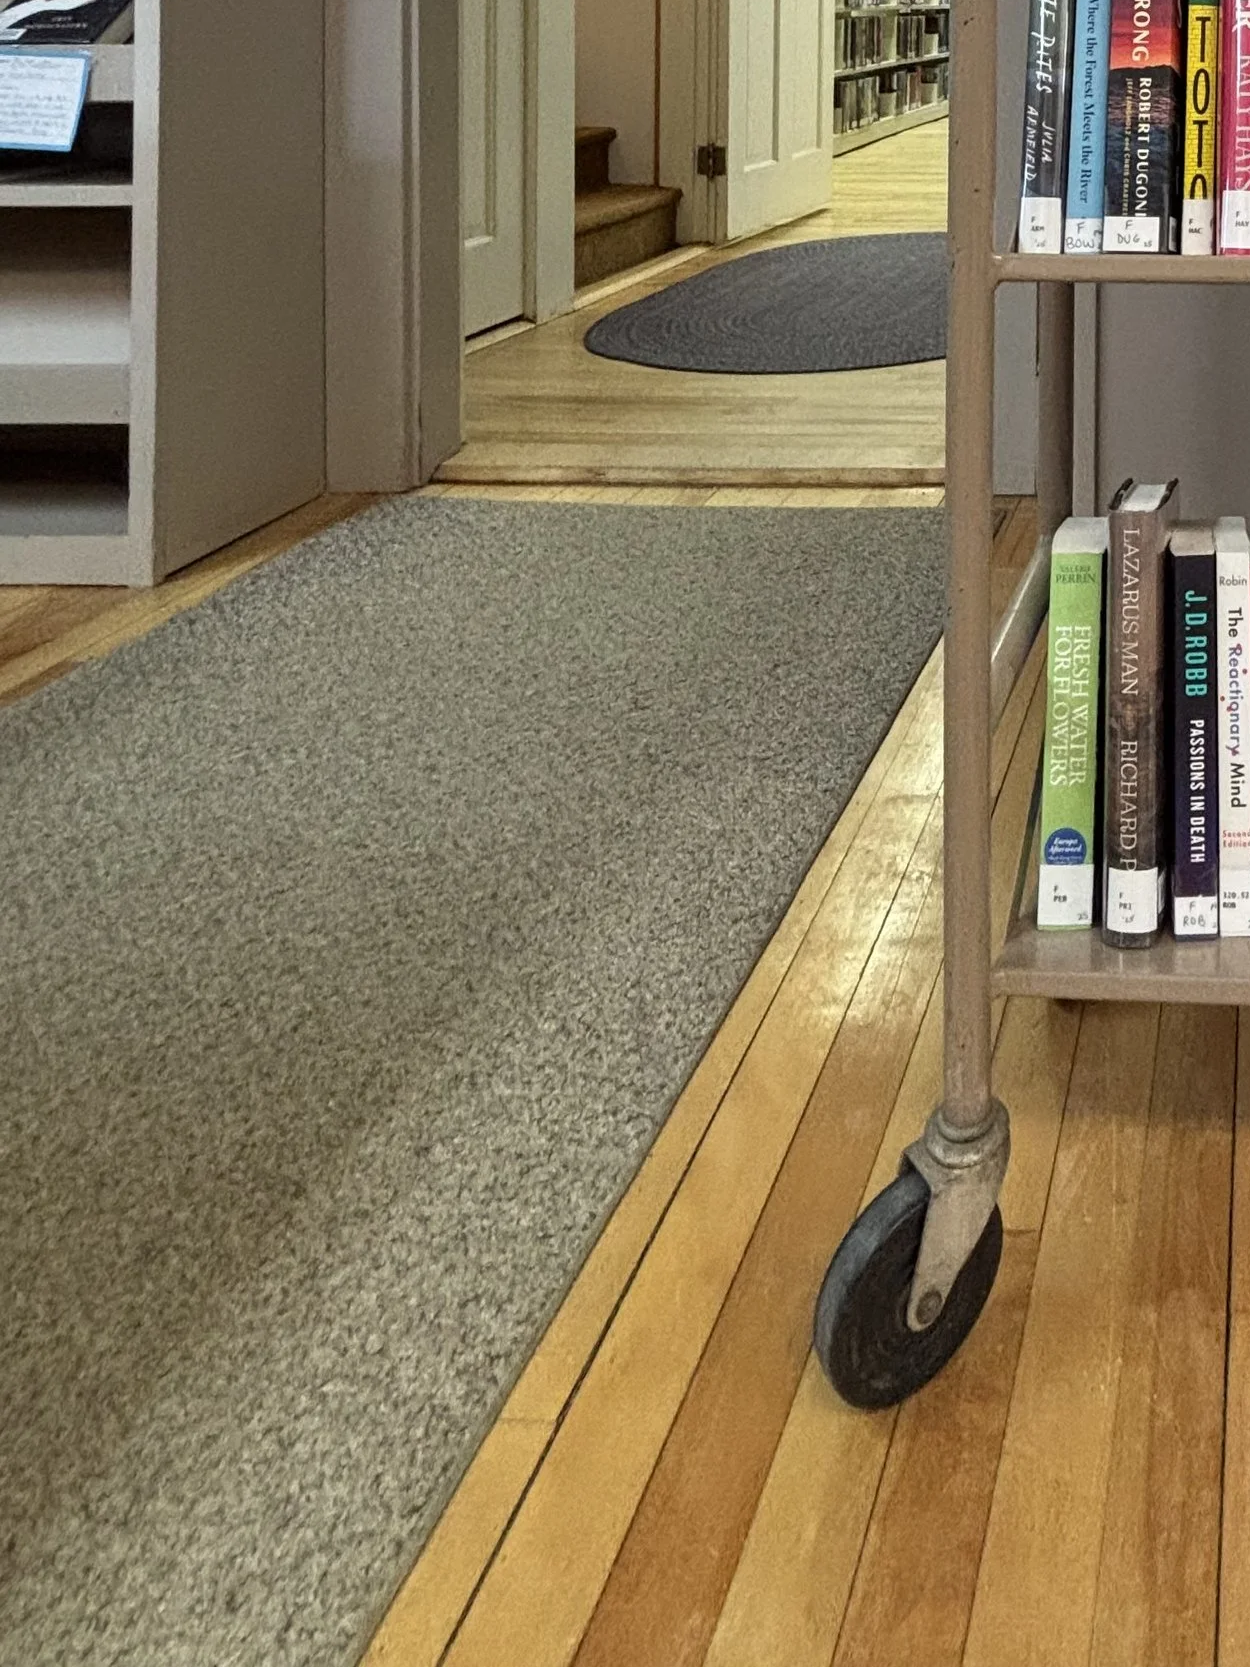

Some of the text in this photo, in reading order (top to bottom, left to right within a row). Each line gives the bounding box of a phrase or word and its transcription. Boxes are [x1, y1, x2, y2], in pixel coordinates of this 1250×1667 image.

[1031, 31, 1055, 95] RITES
[1085, 37, 1098, 58] the
[1083, 59, 1097, 99] Forest
[1042, 121, 1056, 163] JULIA
[1082, 101, 1095, 142] Meets
[1081, 145, 1093, 166] the
[1134, 77, 1152, 217] ROBERT DUGONI
[1079, 169, 1092, 204] River
[1065, 237, 1095, 249] BOW
[1117, 233, 1140, 244] DUG
[1055, 574, 1096, 583] PERRIN
[1219, 575, 1248, 587] Robin
[1121, 528, 1140, 696] LAZARUS MAN
[1185, 635, 1207, 697] ROBB
[1050, 625, 1072, 786] FOR FLOWERS
[1068, 625, 1091, 786] FRESH WATER
[1225, 607, 1246, 808] The Reactionary Mind
[1119, 740, 1138, 851] RICHARD
[1190, 719, 1205, 863] PASSIONS IN DEATH
[1183, 915, 1206, 926] ROB
